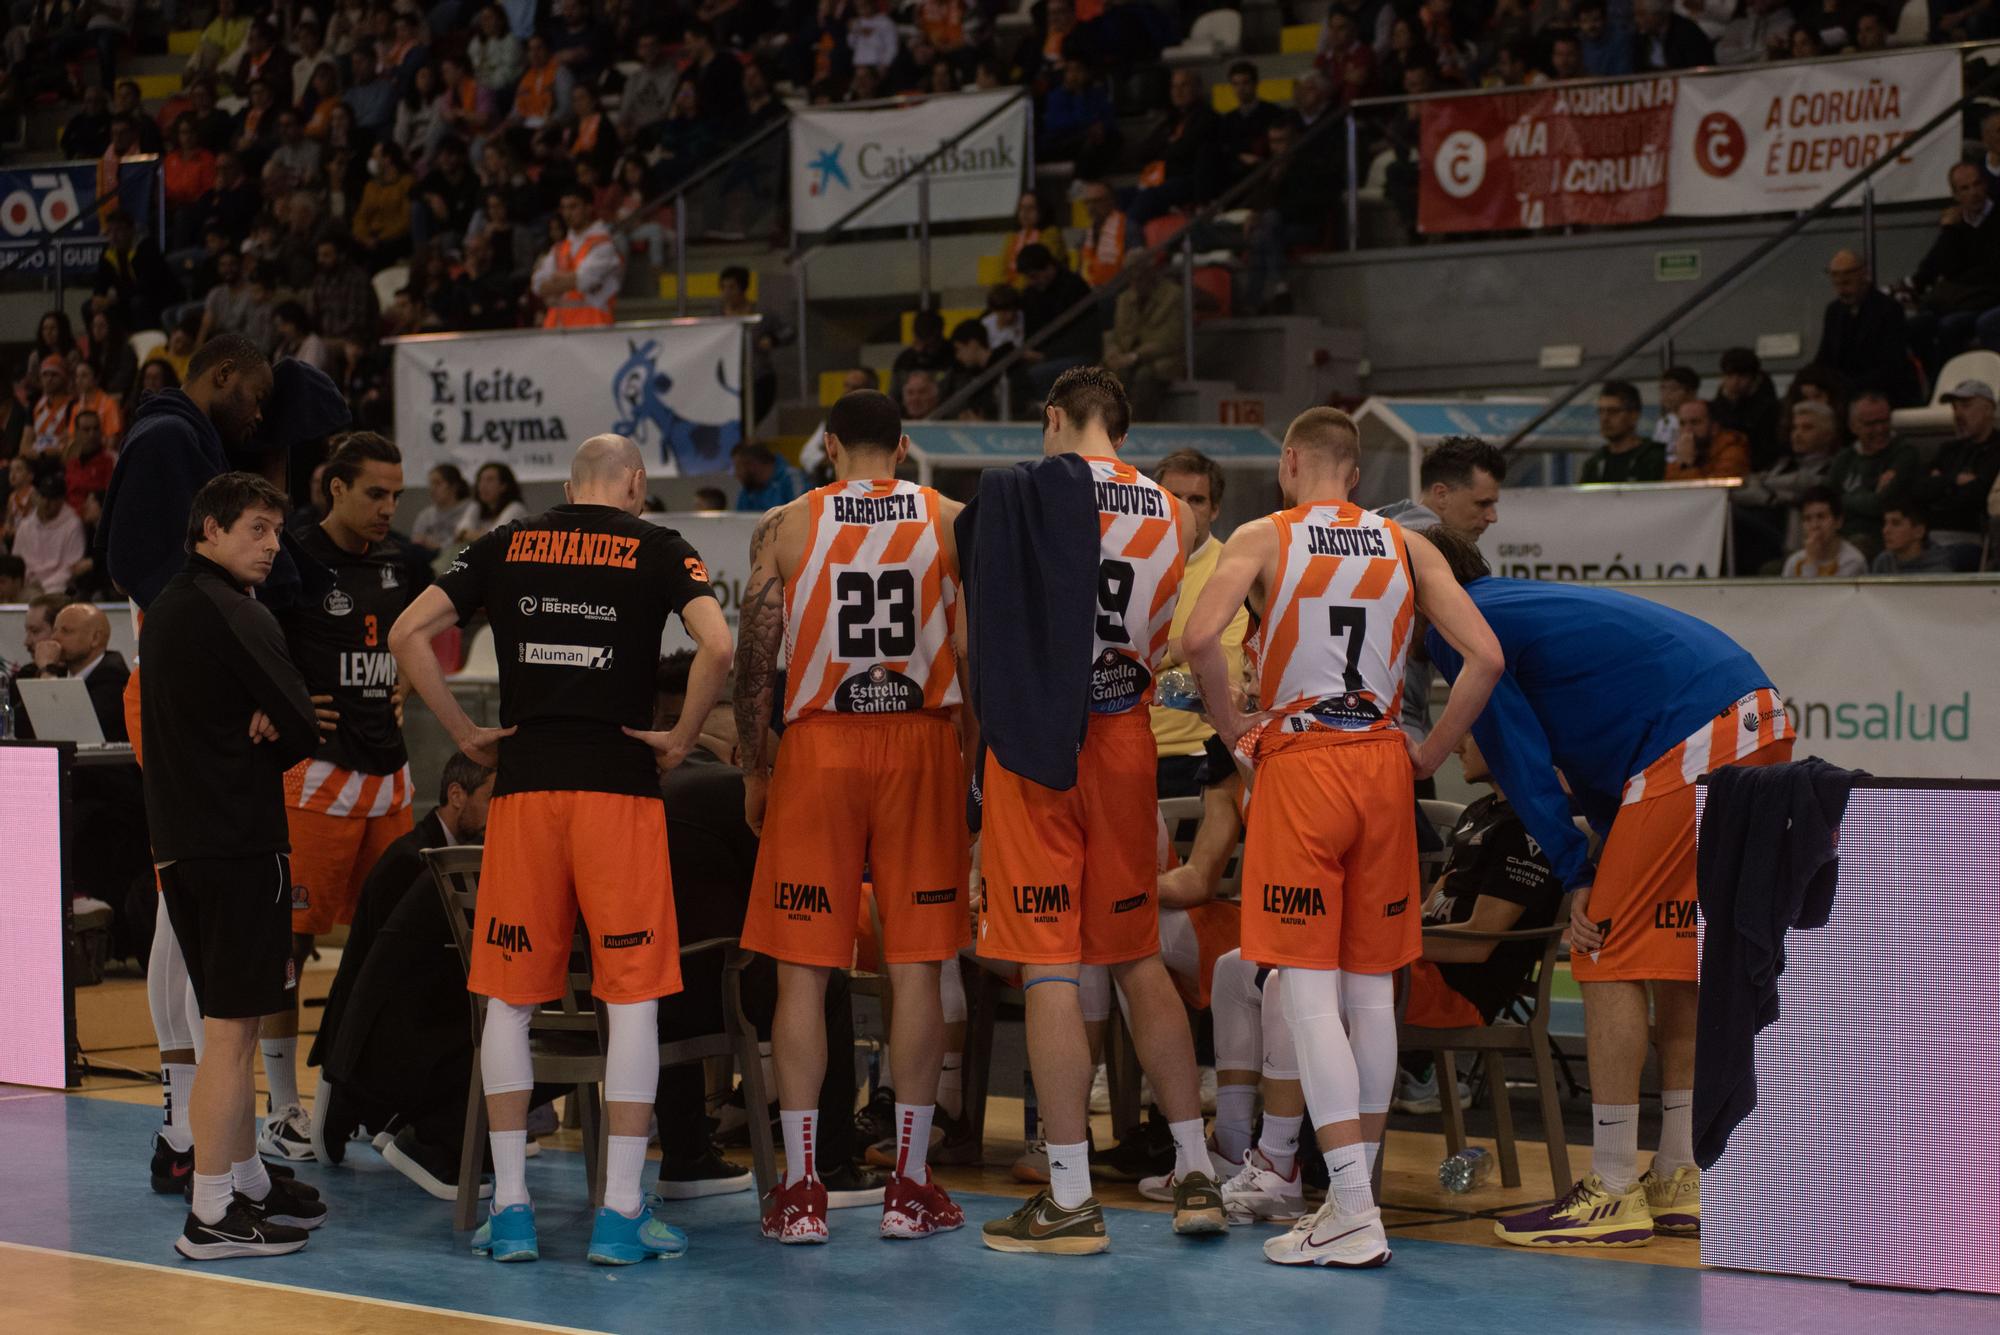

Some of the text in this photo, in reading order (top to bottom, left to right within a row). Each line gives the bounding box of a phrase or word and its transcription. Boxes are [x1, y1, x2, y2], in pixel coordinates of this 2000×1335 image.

[1765, 79, 1900, 130] A CORUÑA
[1766, 134, 1783, 177] É
[430, 359, 542, 407] É leite,
[431, 411, 566, 449] é Leyma
[834, 494, 918, 525] BARRUETA
[1096, 482, 1164, 517] NDQVIST
[505, 528, 641, 570] HERNÁNDEZ
[1308, 525, 1386, 557] JAKOVIČS
[1499, 543, 1542, 558] GRUPO
[541, 602, 617, 617] IBEREÓLICA
[837, 569, 915, 657] 23
[1096, 558, 1135, 644] 9
[364, 614, 378, 647] 3
[530, 648, 583, 662] Aluman
[1329, 606, 1366, 692] 7
[1091, 664, 1137, 685] Estrella
[362, 689, 387, 698] NATURA
[849, 681, 909, 699] Estrella
[1092, 680, 1135, 701] Galicia
[851, 697, 908, 713] Galicia
[1505, 865, 1545, 884] MARINEDA
[1506, 856, 1550, 875] CUPRA
[1509, 874, 1537, 888] MOTOR
[775, 882, 832, 913] LEYMA
[1013, 884, 1070, 913] LEYMA
[1263, 884, 1326, 916] LEYMA
[788, 913, 812, 922] NATURA
[1281, 917, 1306, 926] NATURA
[606, 935, 641, 947] Aluman
